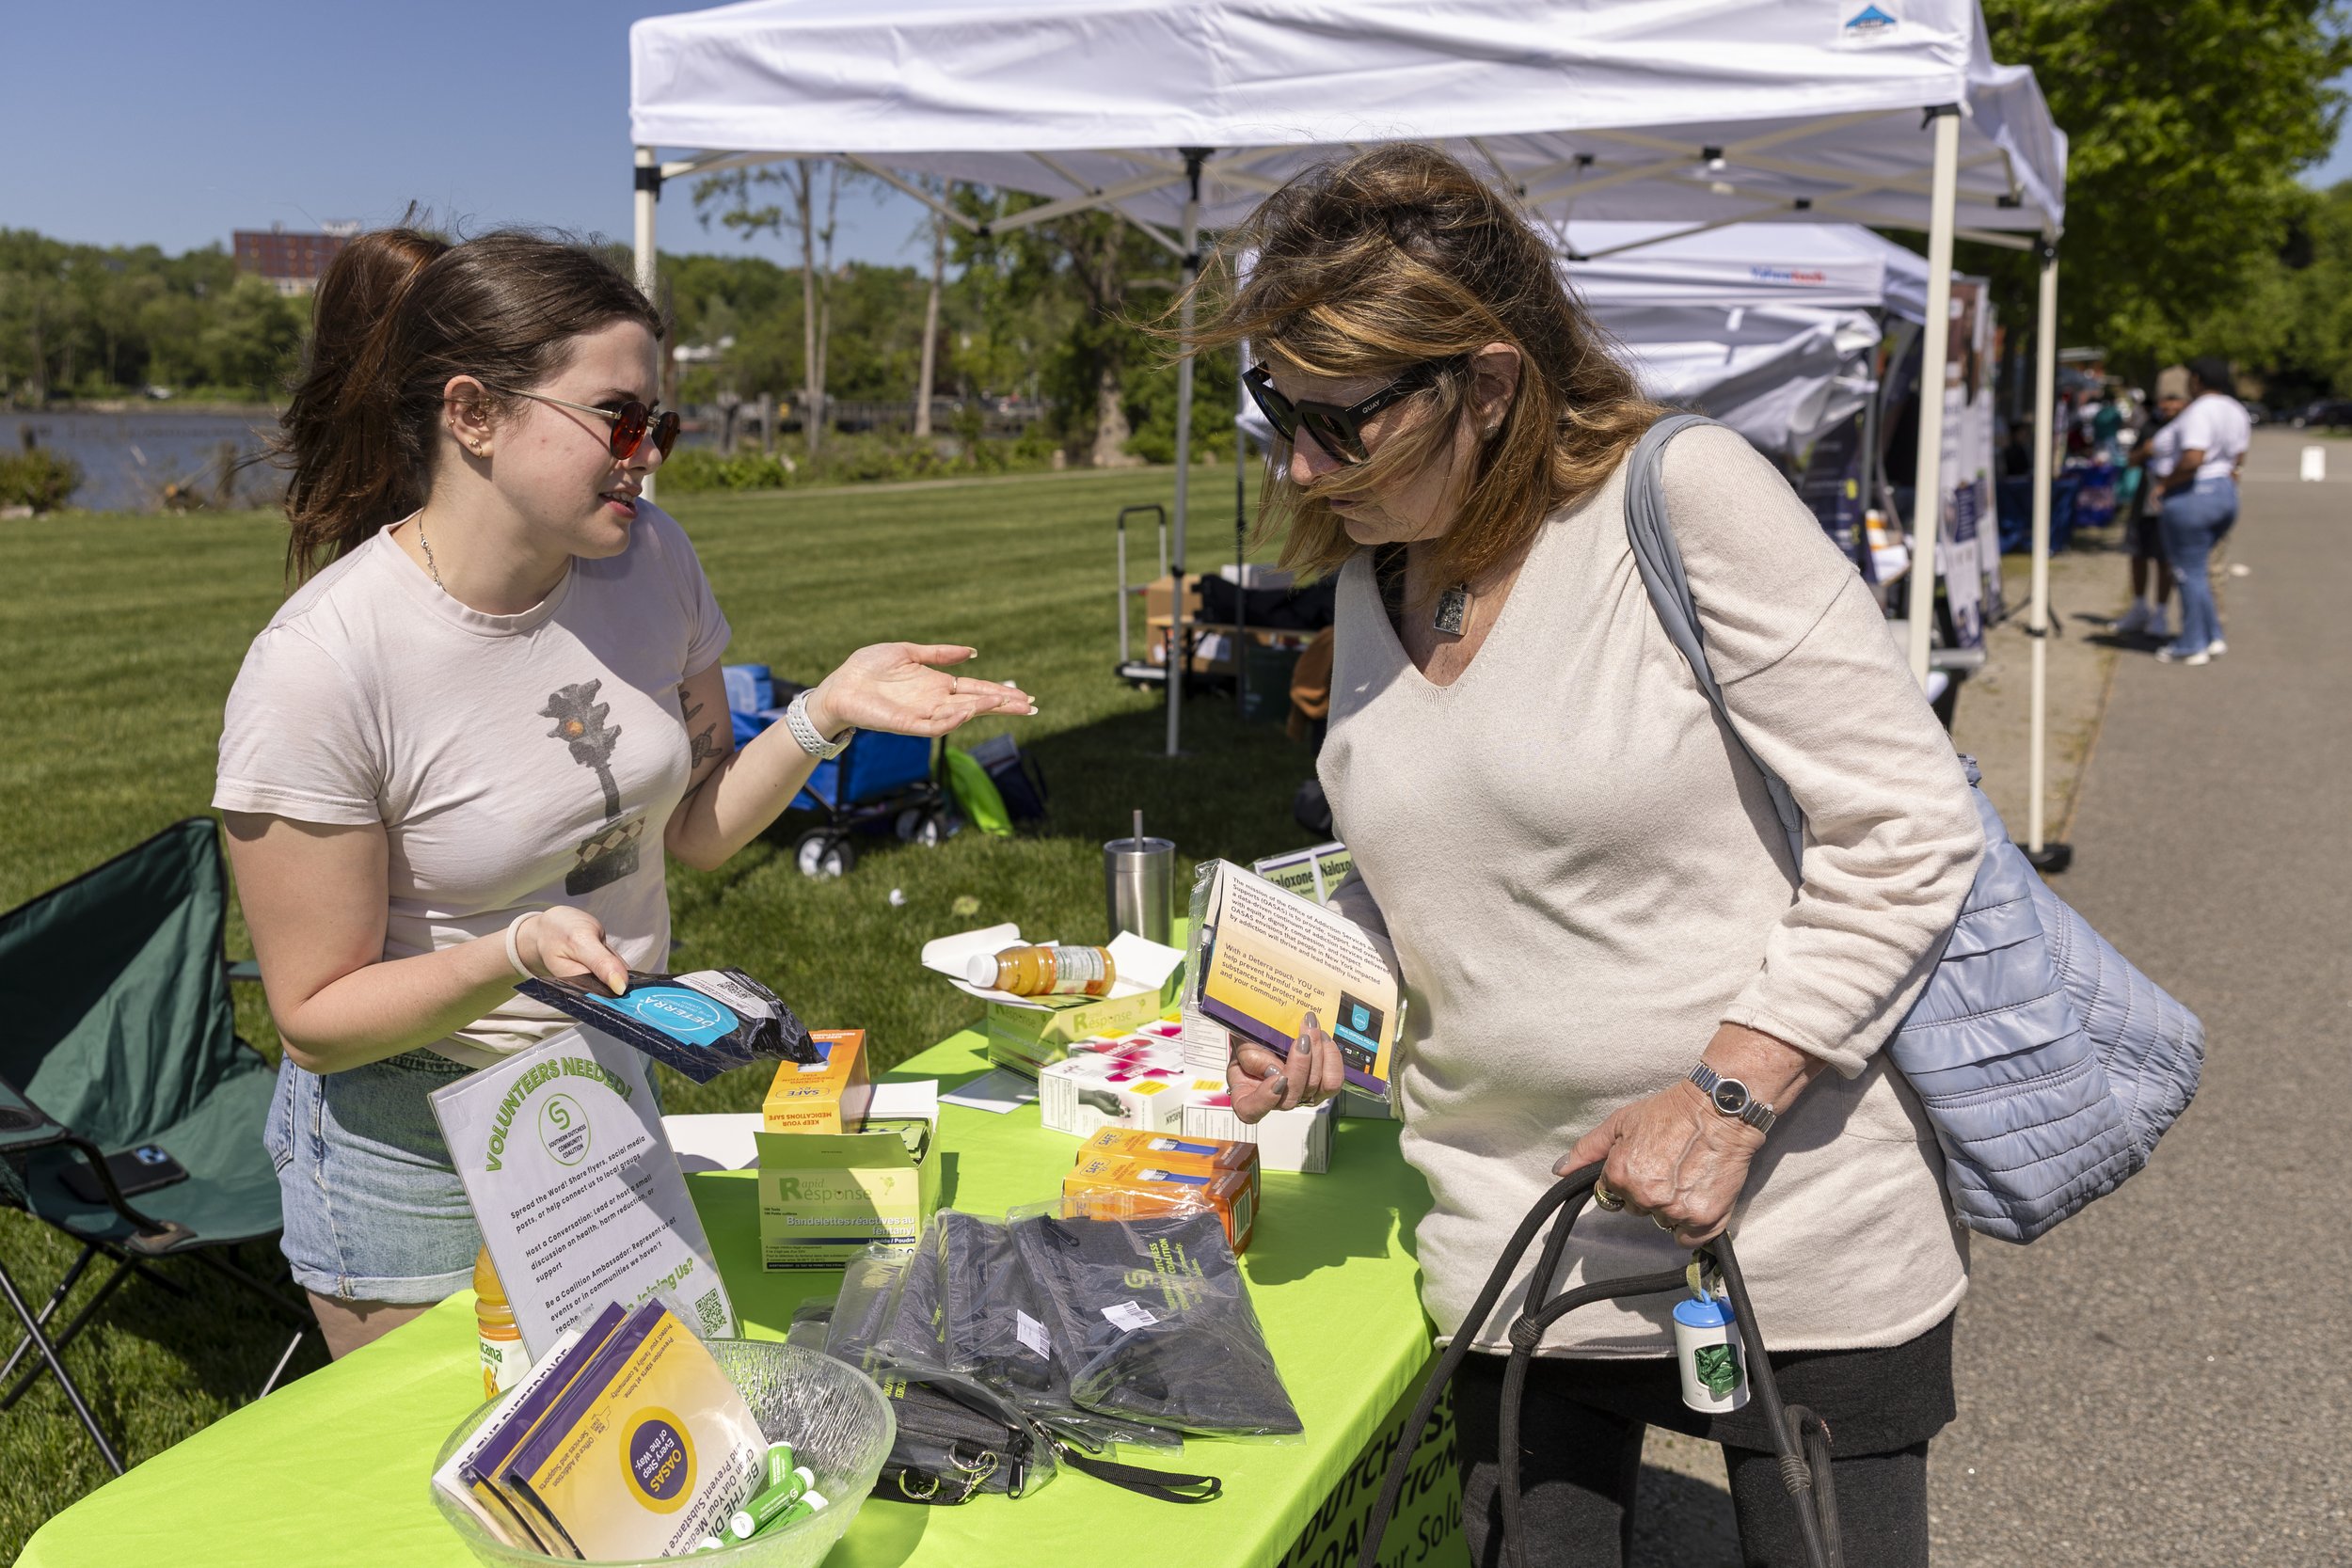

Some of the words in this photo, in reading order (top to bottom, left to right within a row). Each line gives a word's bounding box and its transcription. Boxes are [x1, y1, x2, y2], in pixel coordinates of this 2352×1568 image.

[1271, 871, 1313, 888] aloxone
[1319, 860, 1350, 879] Naloxo
[1232, 898, 1245, 909] with
[1246, 905, 1266, 920] equity,
[1267, 915, 1289, 931] dignity,
[1290, 927, 1327, 950] compassion,
[1327, 946, 1338, 956] and
[1230, 912, 1237, 922] by
[1238, 917, 1266, 936] addiction
[1267, 932, 1279, 942] will
[1279, 938, 1296, 951] thrive
[1298, 947, 1309, 957] and
[1311, 953, 1323, 963] lead
[1324, 960, 1345, 976] healthy
[1346, 972, 1361, 983] lives.
[1231, 905, 1253, 921] OASAS
[1255, 917, 1282, 935] envisions
[1283, 932, 1295, 942] that
[1296, 939, 1316, 953] people
[1325, 953, 1338, 963] New
[1340, 960, 1353, 971] York
[1354, 968, 1380, 985] impacted
[1223, 951, 1237, 964] help
[1239, 959, 1263, 976] prevent
[1265, 972, 1290, 989] harmful
[1292, 986, 1302, 994] use
[1304, 990, 1311, 999] of
[1224, 942, 1240, 956] With
[1248, 954, 1273, 972] Deterra
[1296, 977, 1311, 990] YOU
[1313, 987, 1325, 997] can
[1219, 968, 1232, 979] and
[1233, 976, 1248, 989] your
[1249, 984, 1287, 1008] community!
[1221, 960, 1257, 982] substances
[1259, 978, 1271, 989] and
[1272, 985, 1295, 1001] protect
[1295, 997, 1321, 1015] yourself
[645, 997, 715, 1027] DETERRA
[486, 1059, 560, 1171] VOLUNTEERS
[561, 1057, 632, 1101] NEEDED!
[548, 1133, 568, 1148] SOUTHERN
[566, 1124, 587, 1137] DUTCHESS
[556, 1134, 583, 1152] COMMUNITY
[561, 1143, 584, 1158] COALITION
[510, 1200, 535, 1219] Spread
[534, 1193, 548, 1204] the
[547, 1180, 568, 1196] Word!
[567, 1169, 587, 1184] Share
[586, 1157, 609, 1175] flyers,
[607, 1146, 627, 1161] social
[626, 1134, 645, 1150] media
[514, 1214, 538, 1233] posts,
[536, 1210, 546, 1218] or
[545, 1199, 562, 1214] help
[559, 1183, 588, 1204] connect
[586, 1179, 596, 1188] us
[595, 1174, 604, 1183] to
[602, 1164, 619, 1178] local
[618, 1152, 642, 1170] groups
[524, 1243, 542, 1258] Host
[547, 1211, 595, 1243] Conversation:
[592, 1201, 609, 1215] Lead
[608, 1196, 616, 1205] or
[614, 1187, 630, 1200] host
[634, 1173, 652, 1188] small
[529, 1243, 567, 1270] discussion
[565, 1237, 576, 1246] on
[575, 1222, 599, 1241] health,
[598, 1211, 616, 1226] harm
[614, 1192, 647, 1214] reduction,
[646, 1187, 655, 1196] or
[787, 1216, 851, 1227] Bandelettes
[851, 1216, 900, 1226] réactives
[873, 1226, 915, 1236] fentanyl
[544, 1298, 555, 1308] Be
[559, 1275, 592, 1297] Coalition
[589, 1247, 633, 1276] Ambassador:
[630, 1227, 662, 1250] Represent
[660, 1222, 670, 1230] us
[668, 1215, 676, 1225] at
[675, 1257, 693, 1279] Us?
[1159, 1238, 1176, 1274] COALITION
[534, 1261, 564, 1283] support
[549, 1302, 573, 1321] events
[573, 1296, 581, 1306] or
[580, 1291, 588, 1300] in
[588, 1263, 629, 1294] communities
[629, 1258, 639, 1267] we
[554, 1314, 580, 1334] reache
[657, 1323, 673, 1340] Protect
[647, 1338, 660, 1351] your
[651, 1337, 674, 1363] Prevention
[635, 1349, 651, 1367] family
[640, 1362, 654, 1377] starts
[609, 1370, 635, 1400] community.
[623, 1382, 638, 1400] home.
[567, 1429, 590, 1454] Services
[579, 1435, 595, 1455] Office
[648, 1437, 661, 1453] the
[657, 1428, 669, 1441] of
[559, 1452, 571, 1465] and
[573, 1451, 582, 1462] of
[633, 1449, 652, 1471] Way.
[653, 1435, 675, 1462] Every
[552, 1456, 577, 1489] Addiction
[641, 1457, 660, 1479] Step
[647, 1447, 683, 1493] OASAS
[734, 1448, 755, 1476] Clan
[742, 1461, 762, 1485] BE
[537, 1463, 563, 1491] Supports
[702, 1459, 732, 1499] Prevent
[721, 1474, 738, 1495] Out
[705, 1493, 724, 1519] Your
[723, 1484, 747, 1516] THE
[667, 1496, 707, 1550] Substance
[678, 1516, 709, 1559] Medicin
